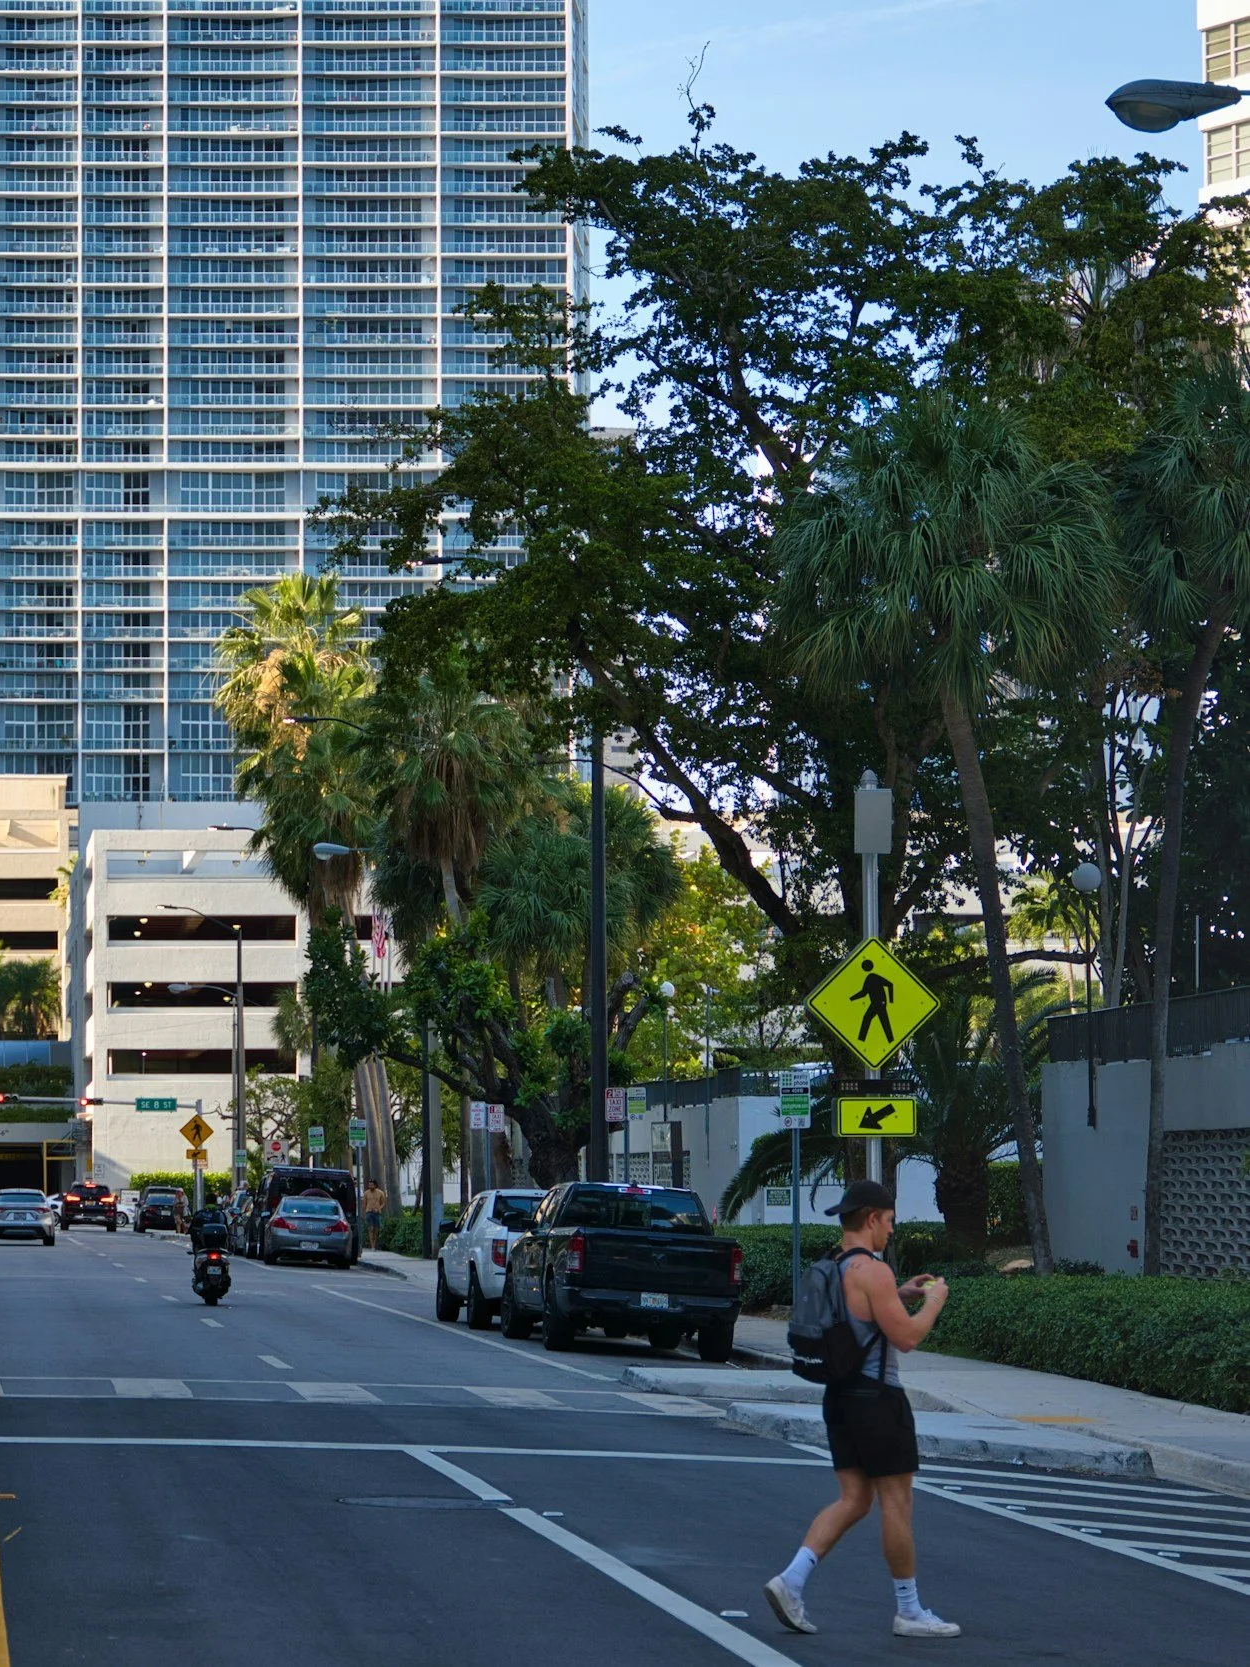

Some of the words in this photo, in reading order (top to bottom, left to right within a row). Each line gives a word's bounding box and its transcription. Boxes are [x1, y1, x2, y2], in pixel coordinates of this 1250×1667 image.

[141, 1101, 150, 1109] SE
[154, 1100, 160, 1109] 8
[163, 1101, 172, 1109] ST
